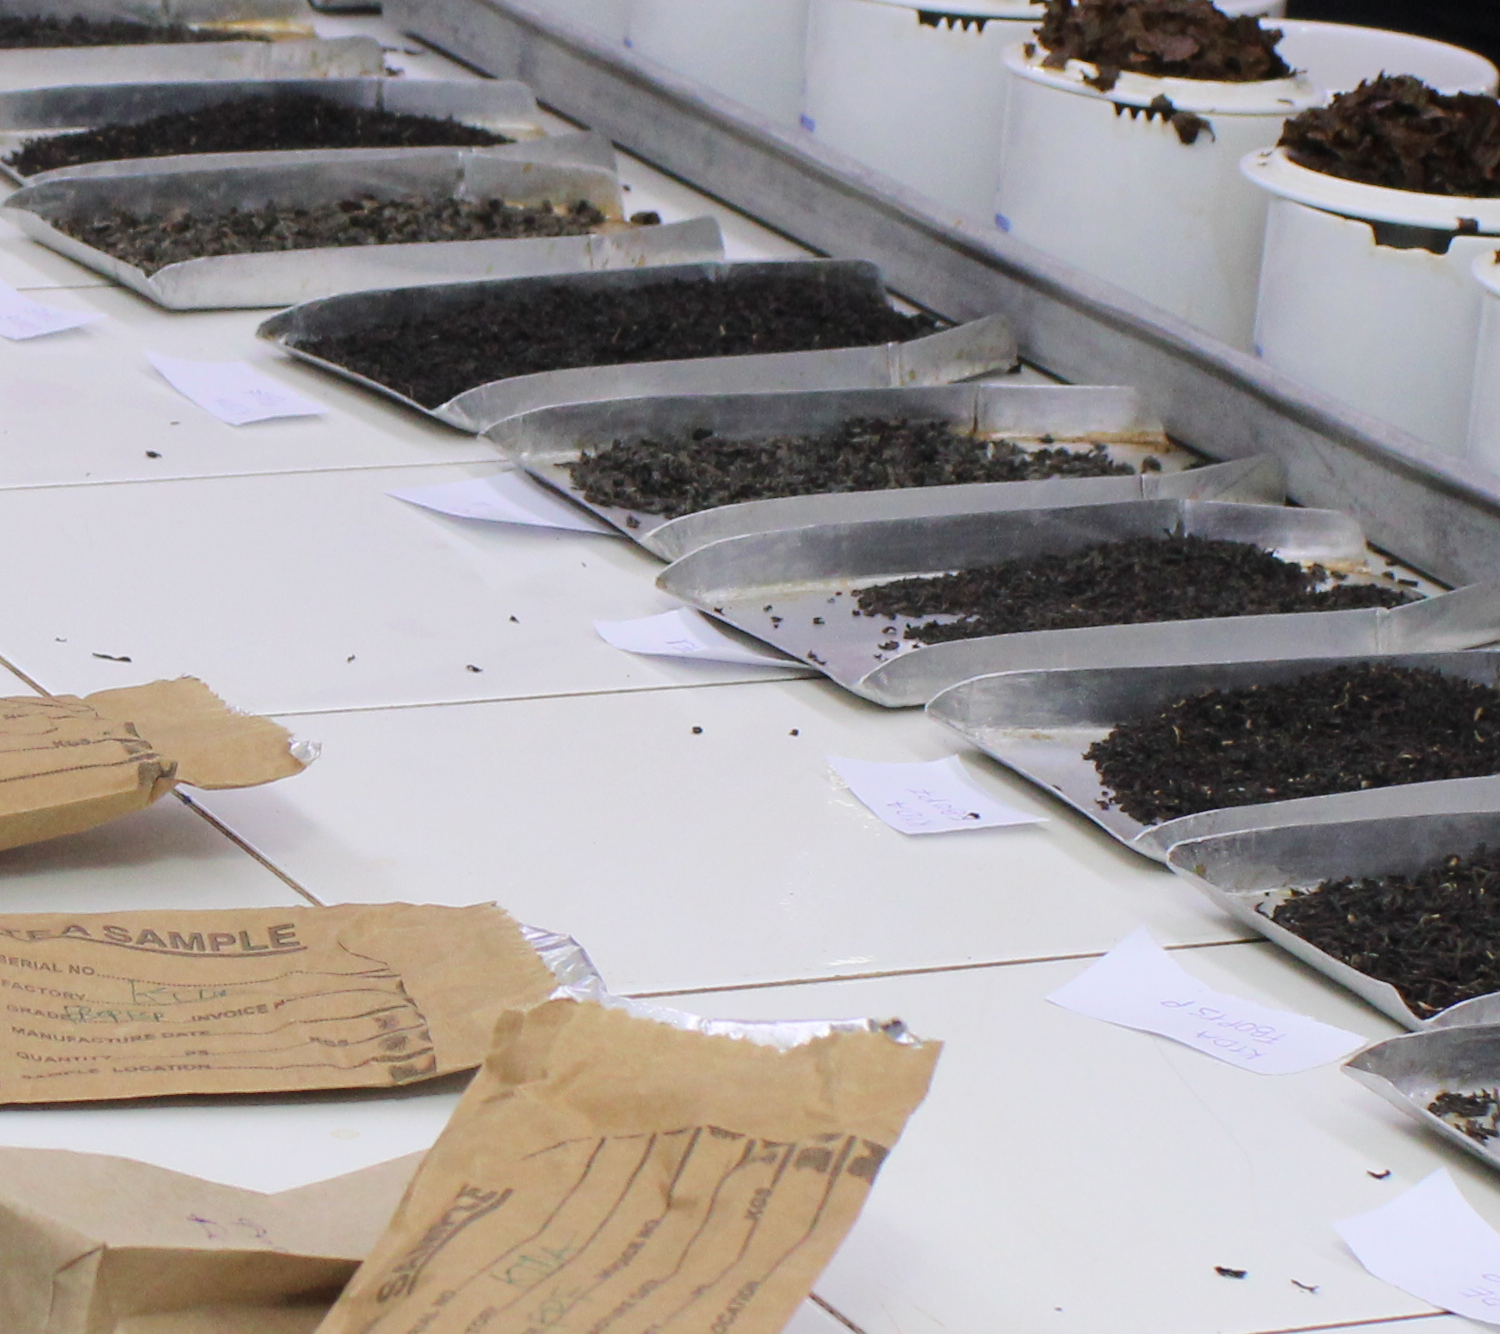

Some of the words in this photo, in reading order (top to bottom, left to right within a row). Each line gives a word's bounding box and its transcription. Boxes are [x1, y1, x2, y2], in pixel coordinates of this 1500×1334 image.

[103, 922, 301, 953] SAMPLE
[1, 979, 87, 1002] FACTORY
[191, 1003, 269, 1022] INVOICE
[10, 1025, 157, 1045] MANUFACTURE
[15, 1050, 112, 1064] QUANTITY
[375, 1182, 499, 1304] SAMPLE
